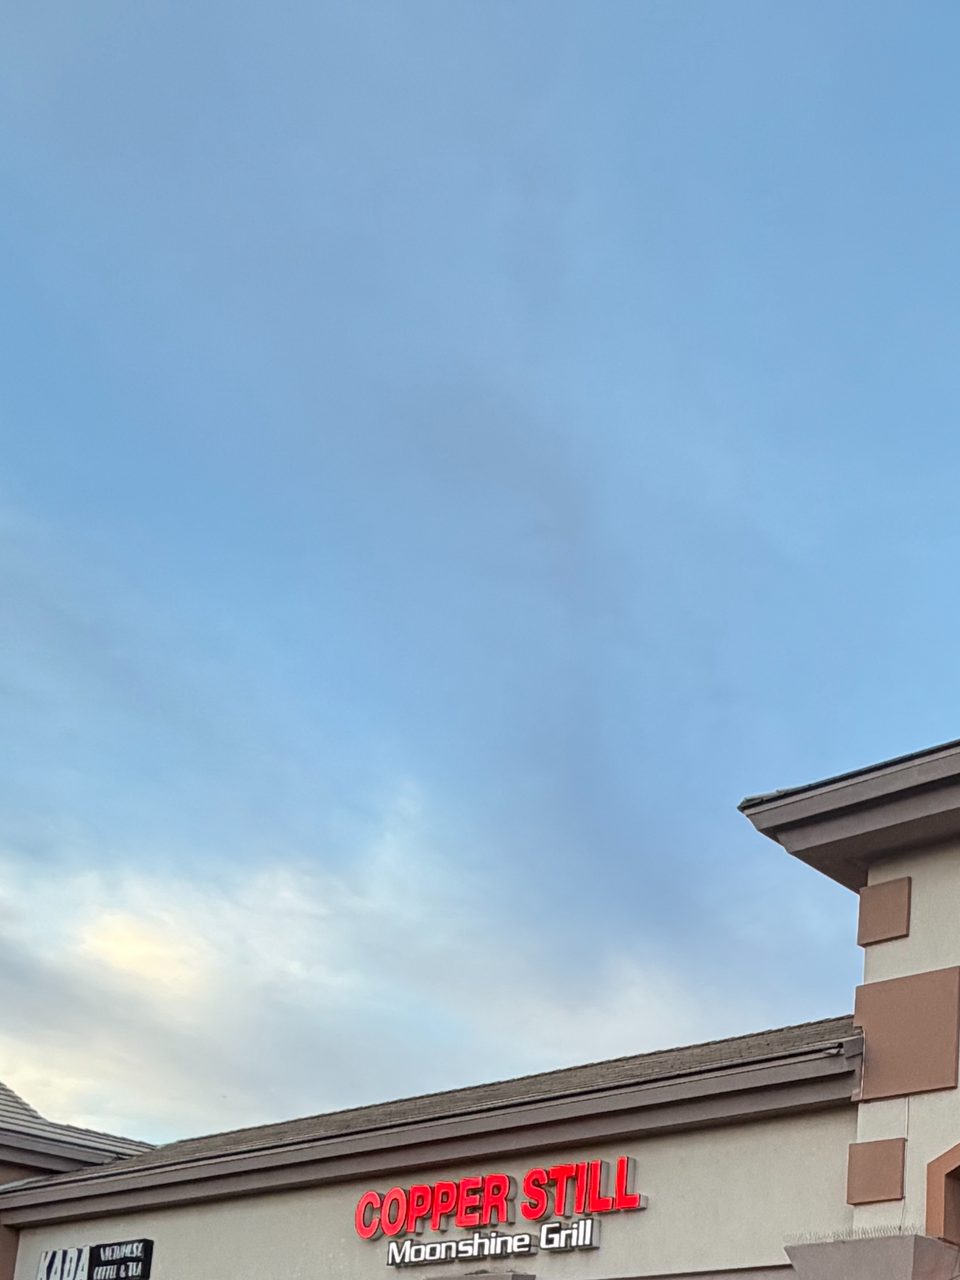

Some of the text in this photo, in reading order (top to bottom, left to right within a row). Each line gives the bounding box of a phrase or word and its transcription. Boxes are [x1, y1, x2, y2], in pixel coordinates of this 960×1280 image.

[354, 1155, 642, 1240] COPPER STILL
[387, 1219, 594, 1266] Moonshine Grill
